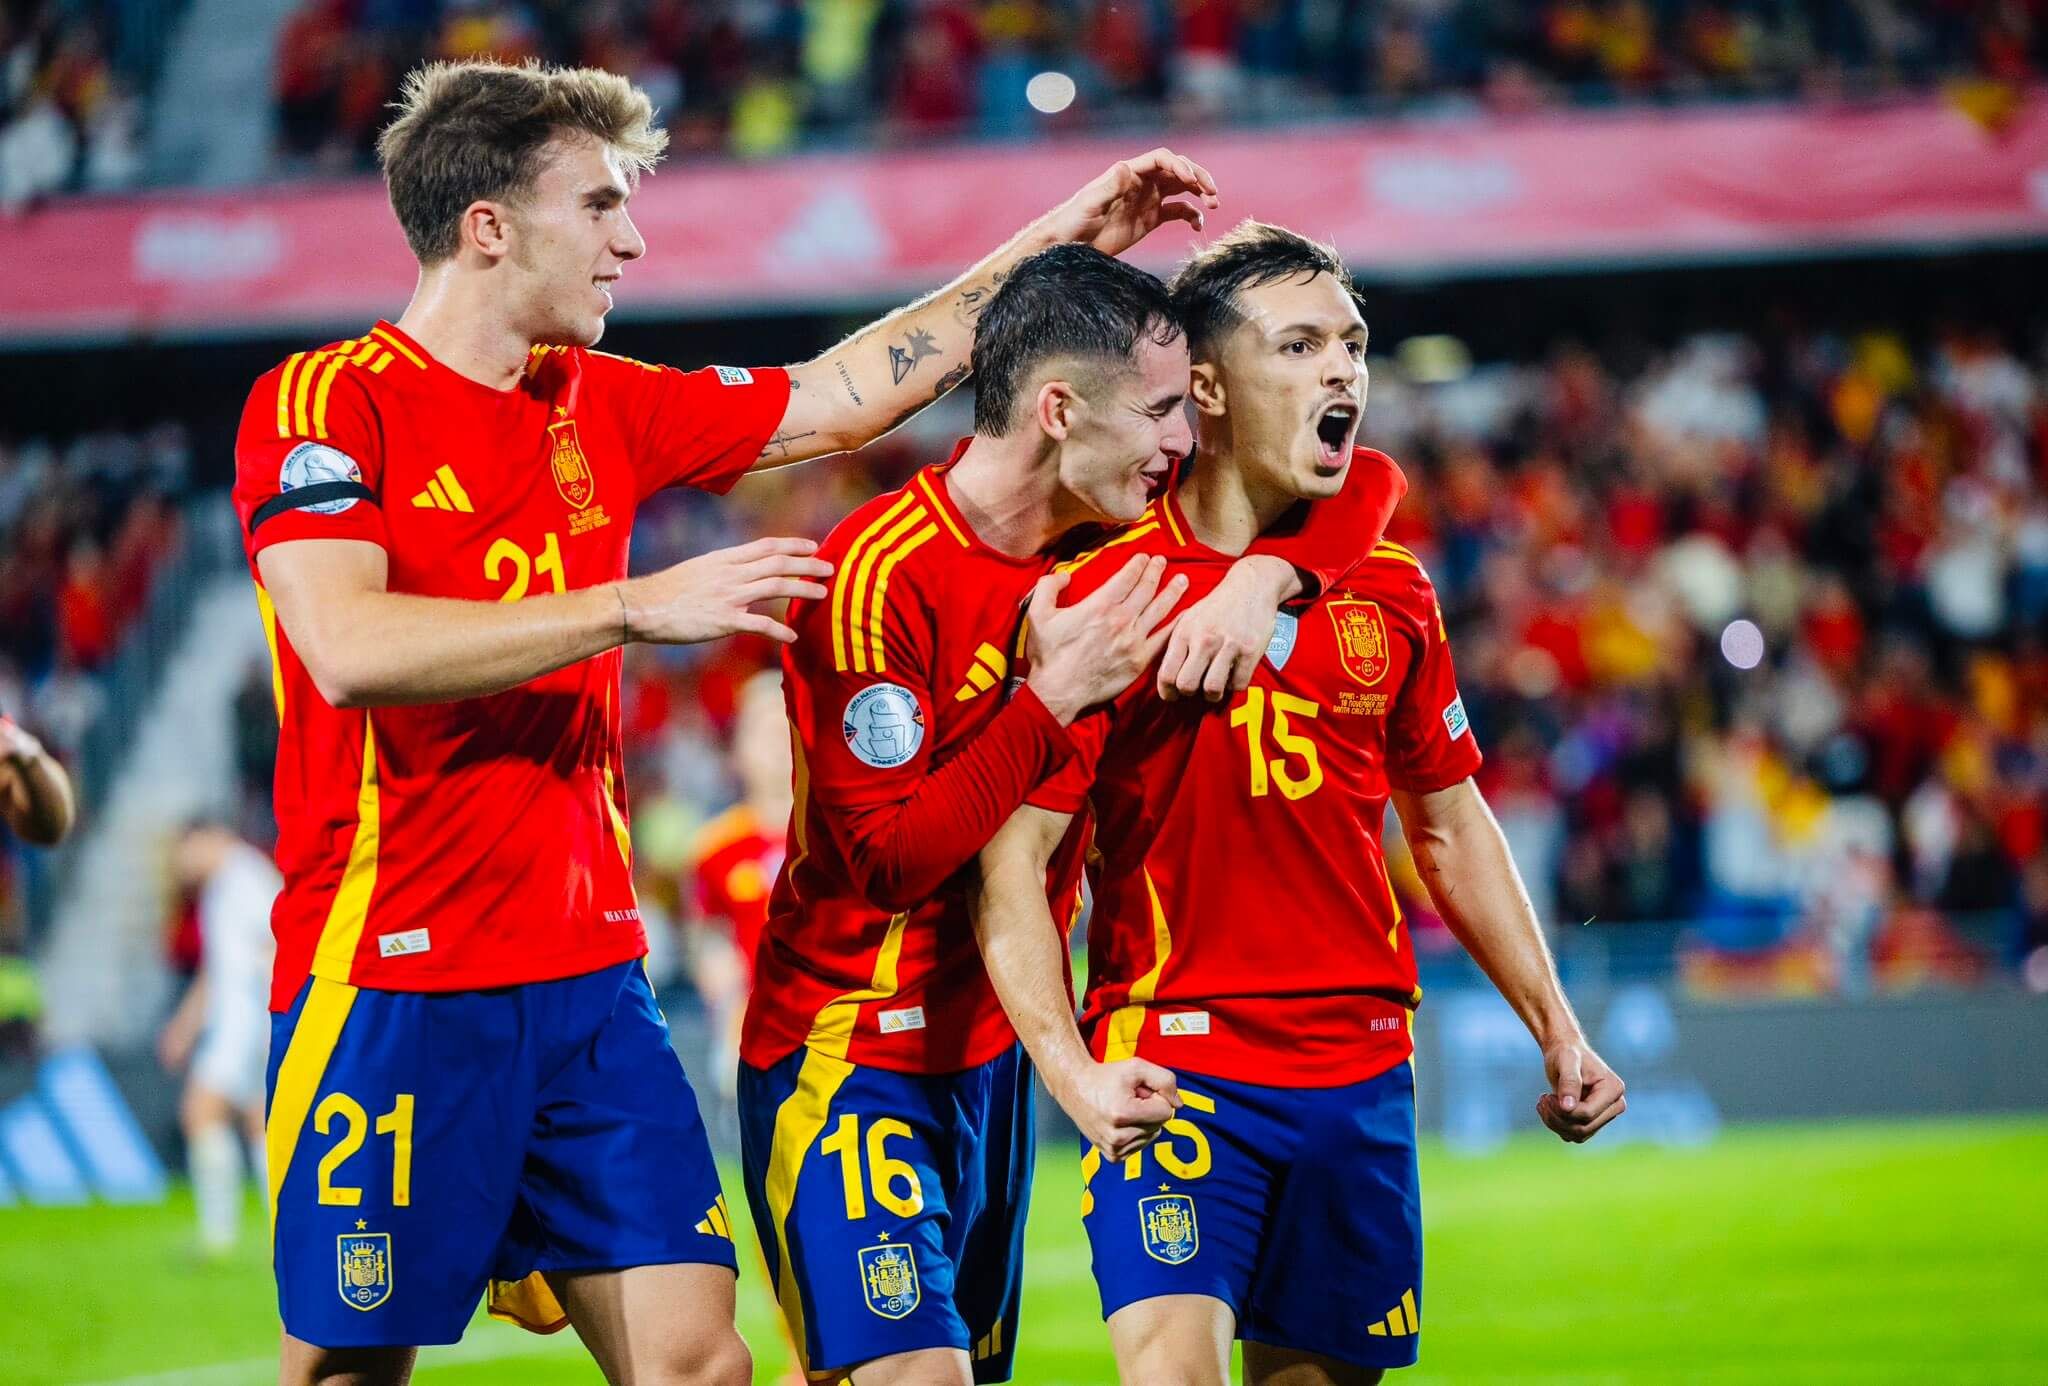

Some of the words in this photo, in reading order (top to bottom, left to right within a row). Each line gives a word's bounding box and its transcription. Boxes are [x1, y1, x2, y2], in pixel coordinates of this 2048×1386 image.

[484, 532, 567, 604] 21
[849, 698, 861, 712] UEFA
[861, 687, 888, 700] NATIONS
[889, 686, 912, 700] LEAGUE
[1230, 686, 1324, 800] 15
[314, 1092, 414, 1206] 21
[821, 1113, 924, 1220] 16
